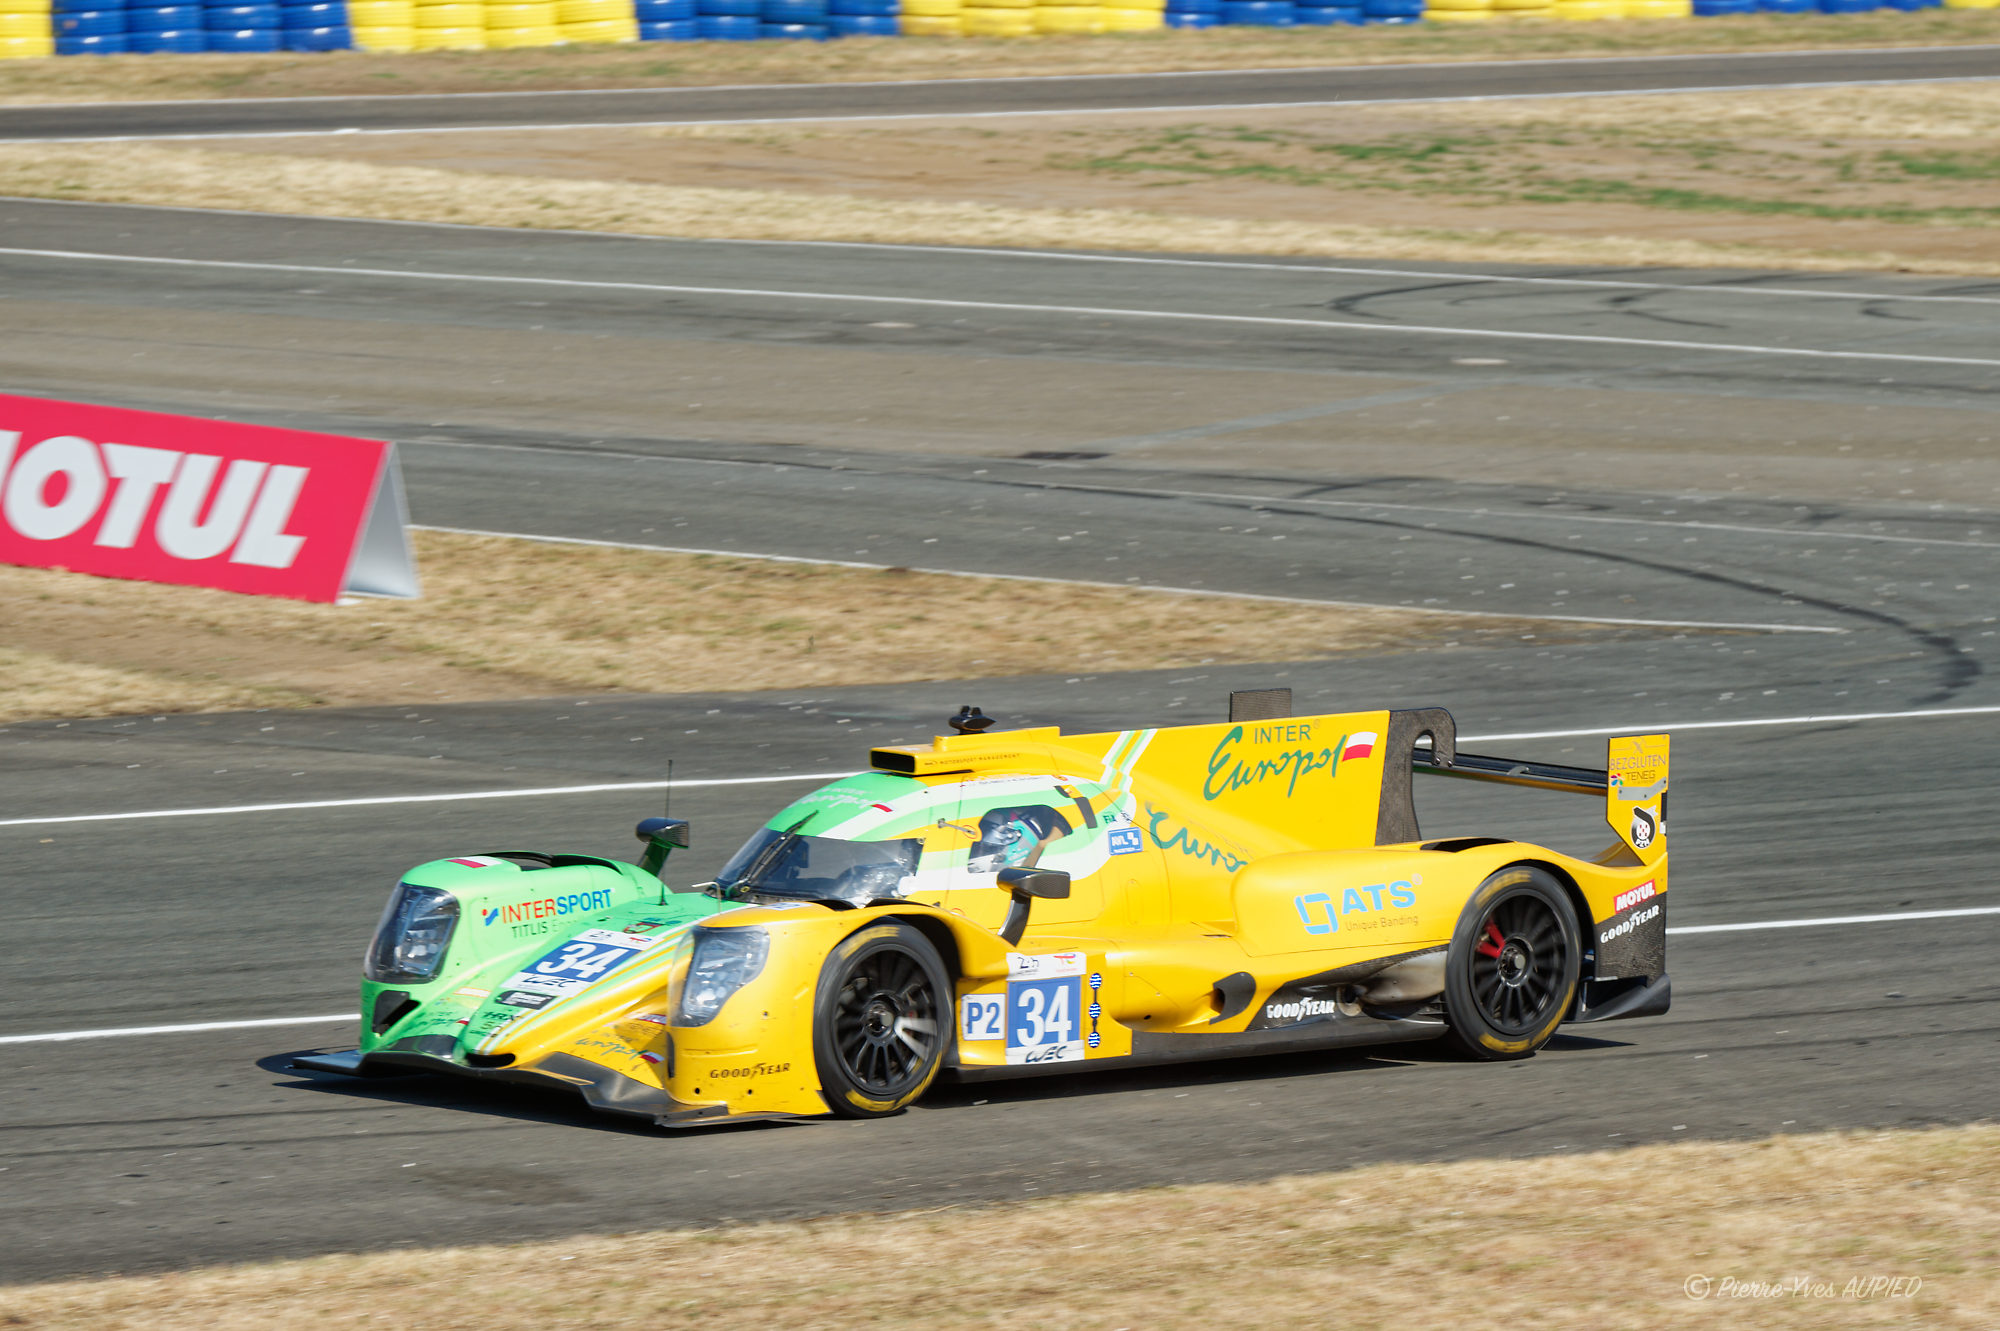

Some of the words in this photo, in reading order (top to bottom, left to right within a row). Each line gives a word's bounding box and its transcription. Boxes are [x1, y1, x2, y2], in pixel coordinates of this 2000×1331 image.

[1254, 724, 1312, 744] INTER
[1203, 726, 1347, 800] Europol
[1610, 754, 1667, 770] BEZGLUTEN
[502, 889, 612, 923] INTERSPORT
[1342, 880, 1416, 914] ATS
[1616, 882, 1655, 911] MOTUL
[512, 923, 548, 938] TITLIS
[1345, 920, 1378, 931] Unique
[1600, 904, 1659, 943] GOODYEAR
[536, 943, 631, 979] 34
[967, 1002, 1000, 1034] P2
[1017, 986, 1072, 1047] 34
[1266, 996, 1335, 1021] GOODYEAR
[1025, 1046, 1067, 1063] WEC
[710, 1062, 791, 1080] GOODYEAR
